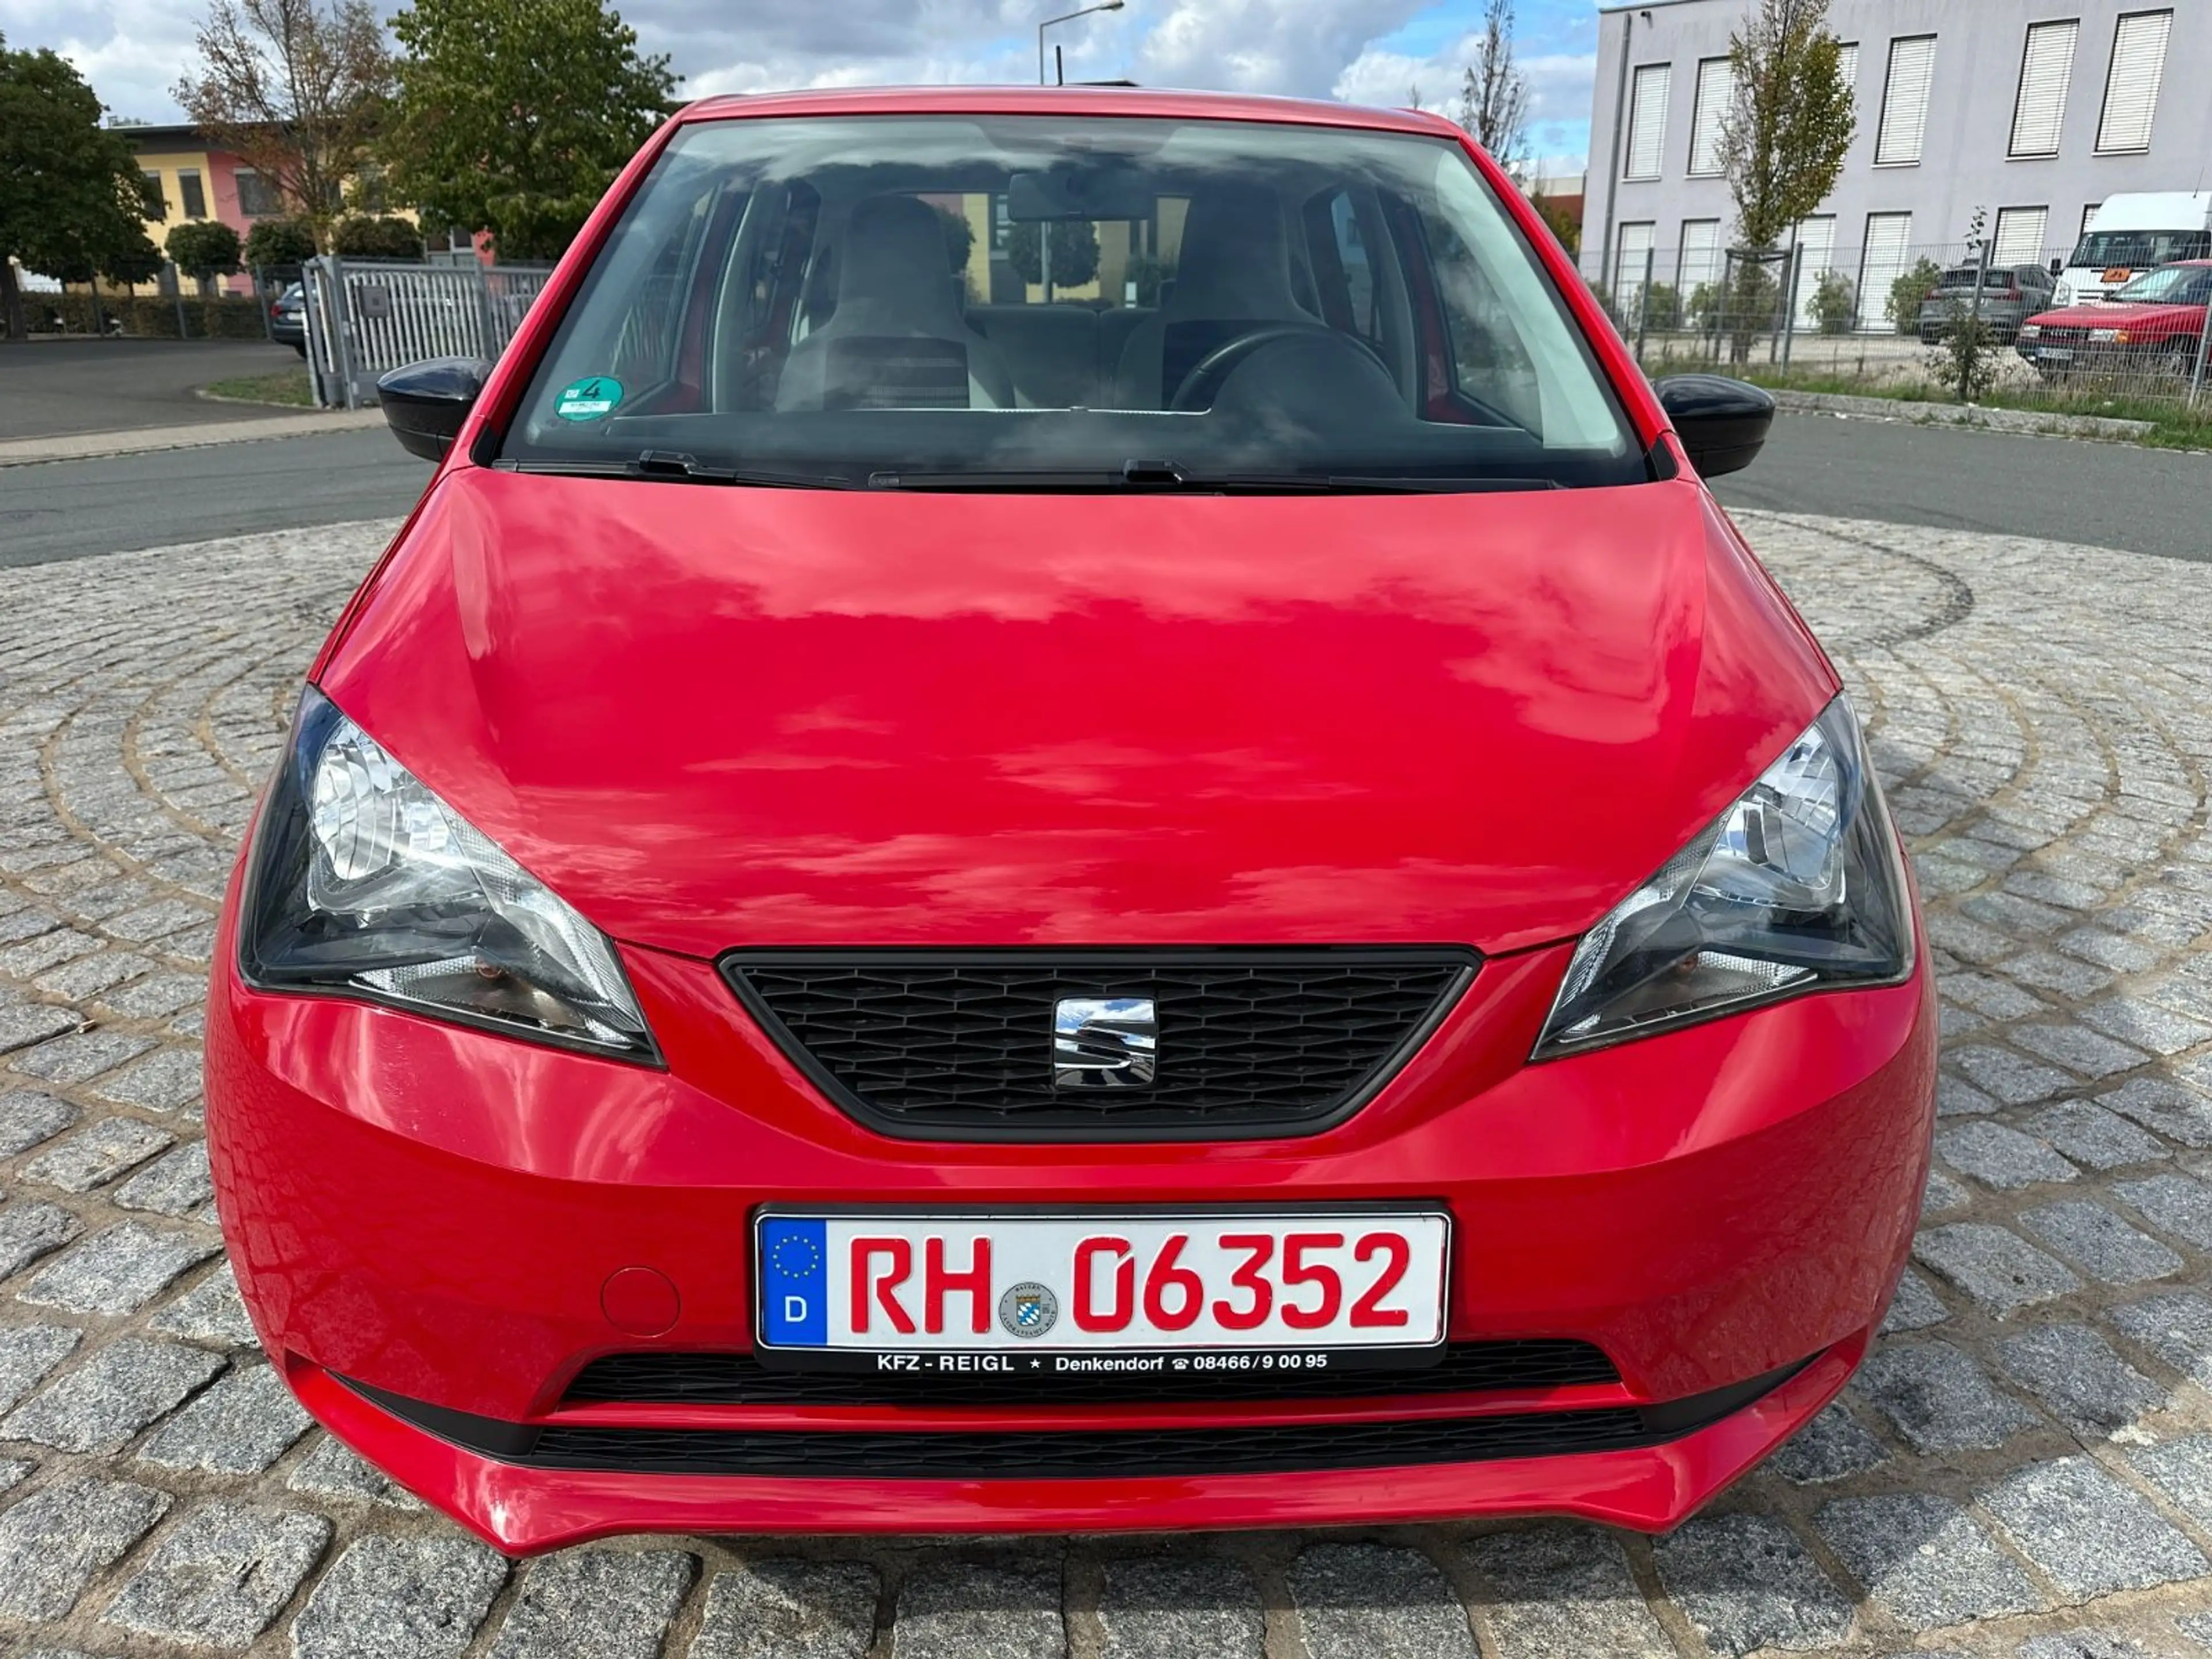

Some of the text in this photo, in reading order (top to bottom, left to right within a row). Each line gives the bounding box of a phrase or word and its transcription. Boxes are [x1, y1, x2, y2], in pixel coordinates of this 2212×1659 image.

[581, 380, 601, 399] 4
[850, 1231, 1411, 1335] RH 06352
[785, 1296, 807, 1323] D
[940, 1355, 1015, 1371] REIGL
[1055, 1356, 1164, 1371] Denkendorf
[1278, 1354, 1301, 1369] 00
[1305, 1354, 1327, 1368] 95
